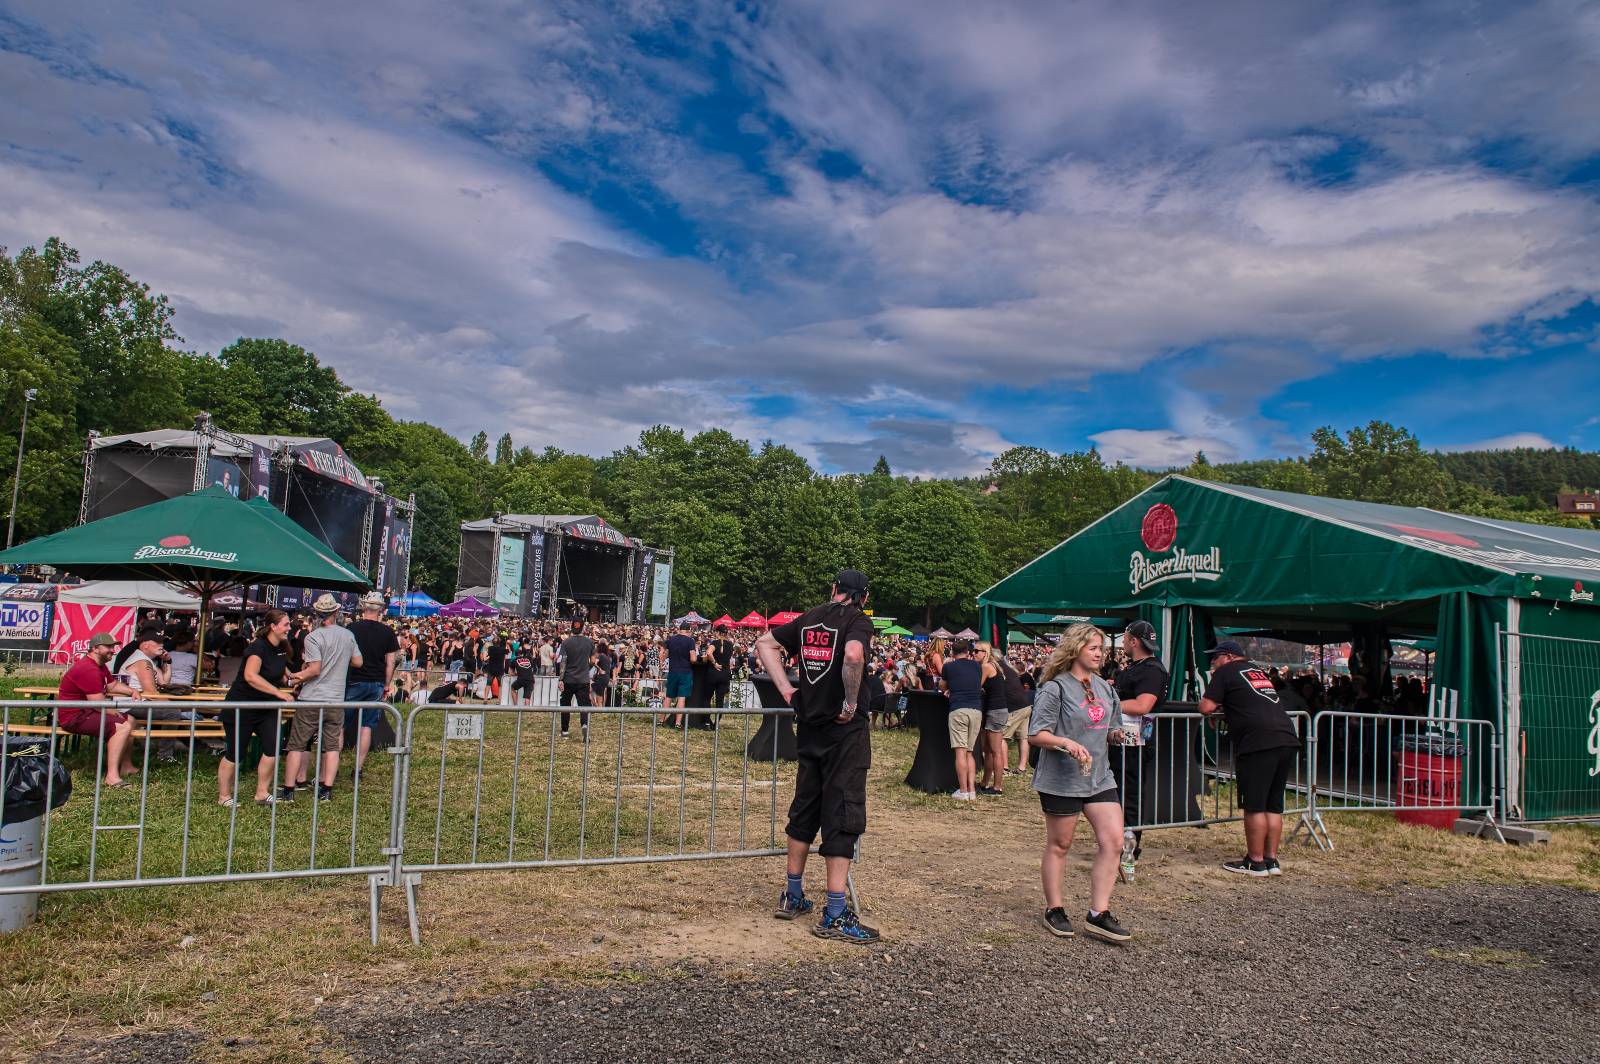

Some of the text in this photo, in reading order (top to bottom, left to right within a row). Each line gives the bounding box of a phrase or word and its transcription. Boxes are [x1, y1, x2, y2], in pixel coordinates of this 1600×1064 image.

[134, 546, 190, 560] Pilsner
[534, 549, 542, 589] SYSTEMS
[1129, 546, 1220, 595] Pilsner Urquell
[531, 591, 540, 614] ALTO
[0, 608, 40, 623] TIKO
[6, 628, 40, 637] Německu
[806, 630, 830, 646] BIG
